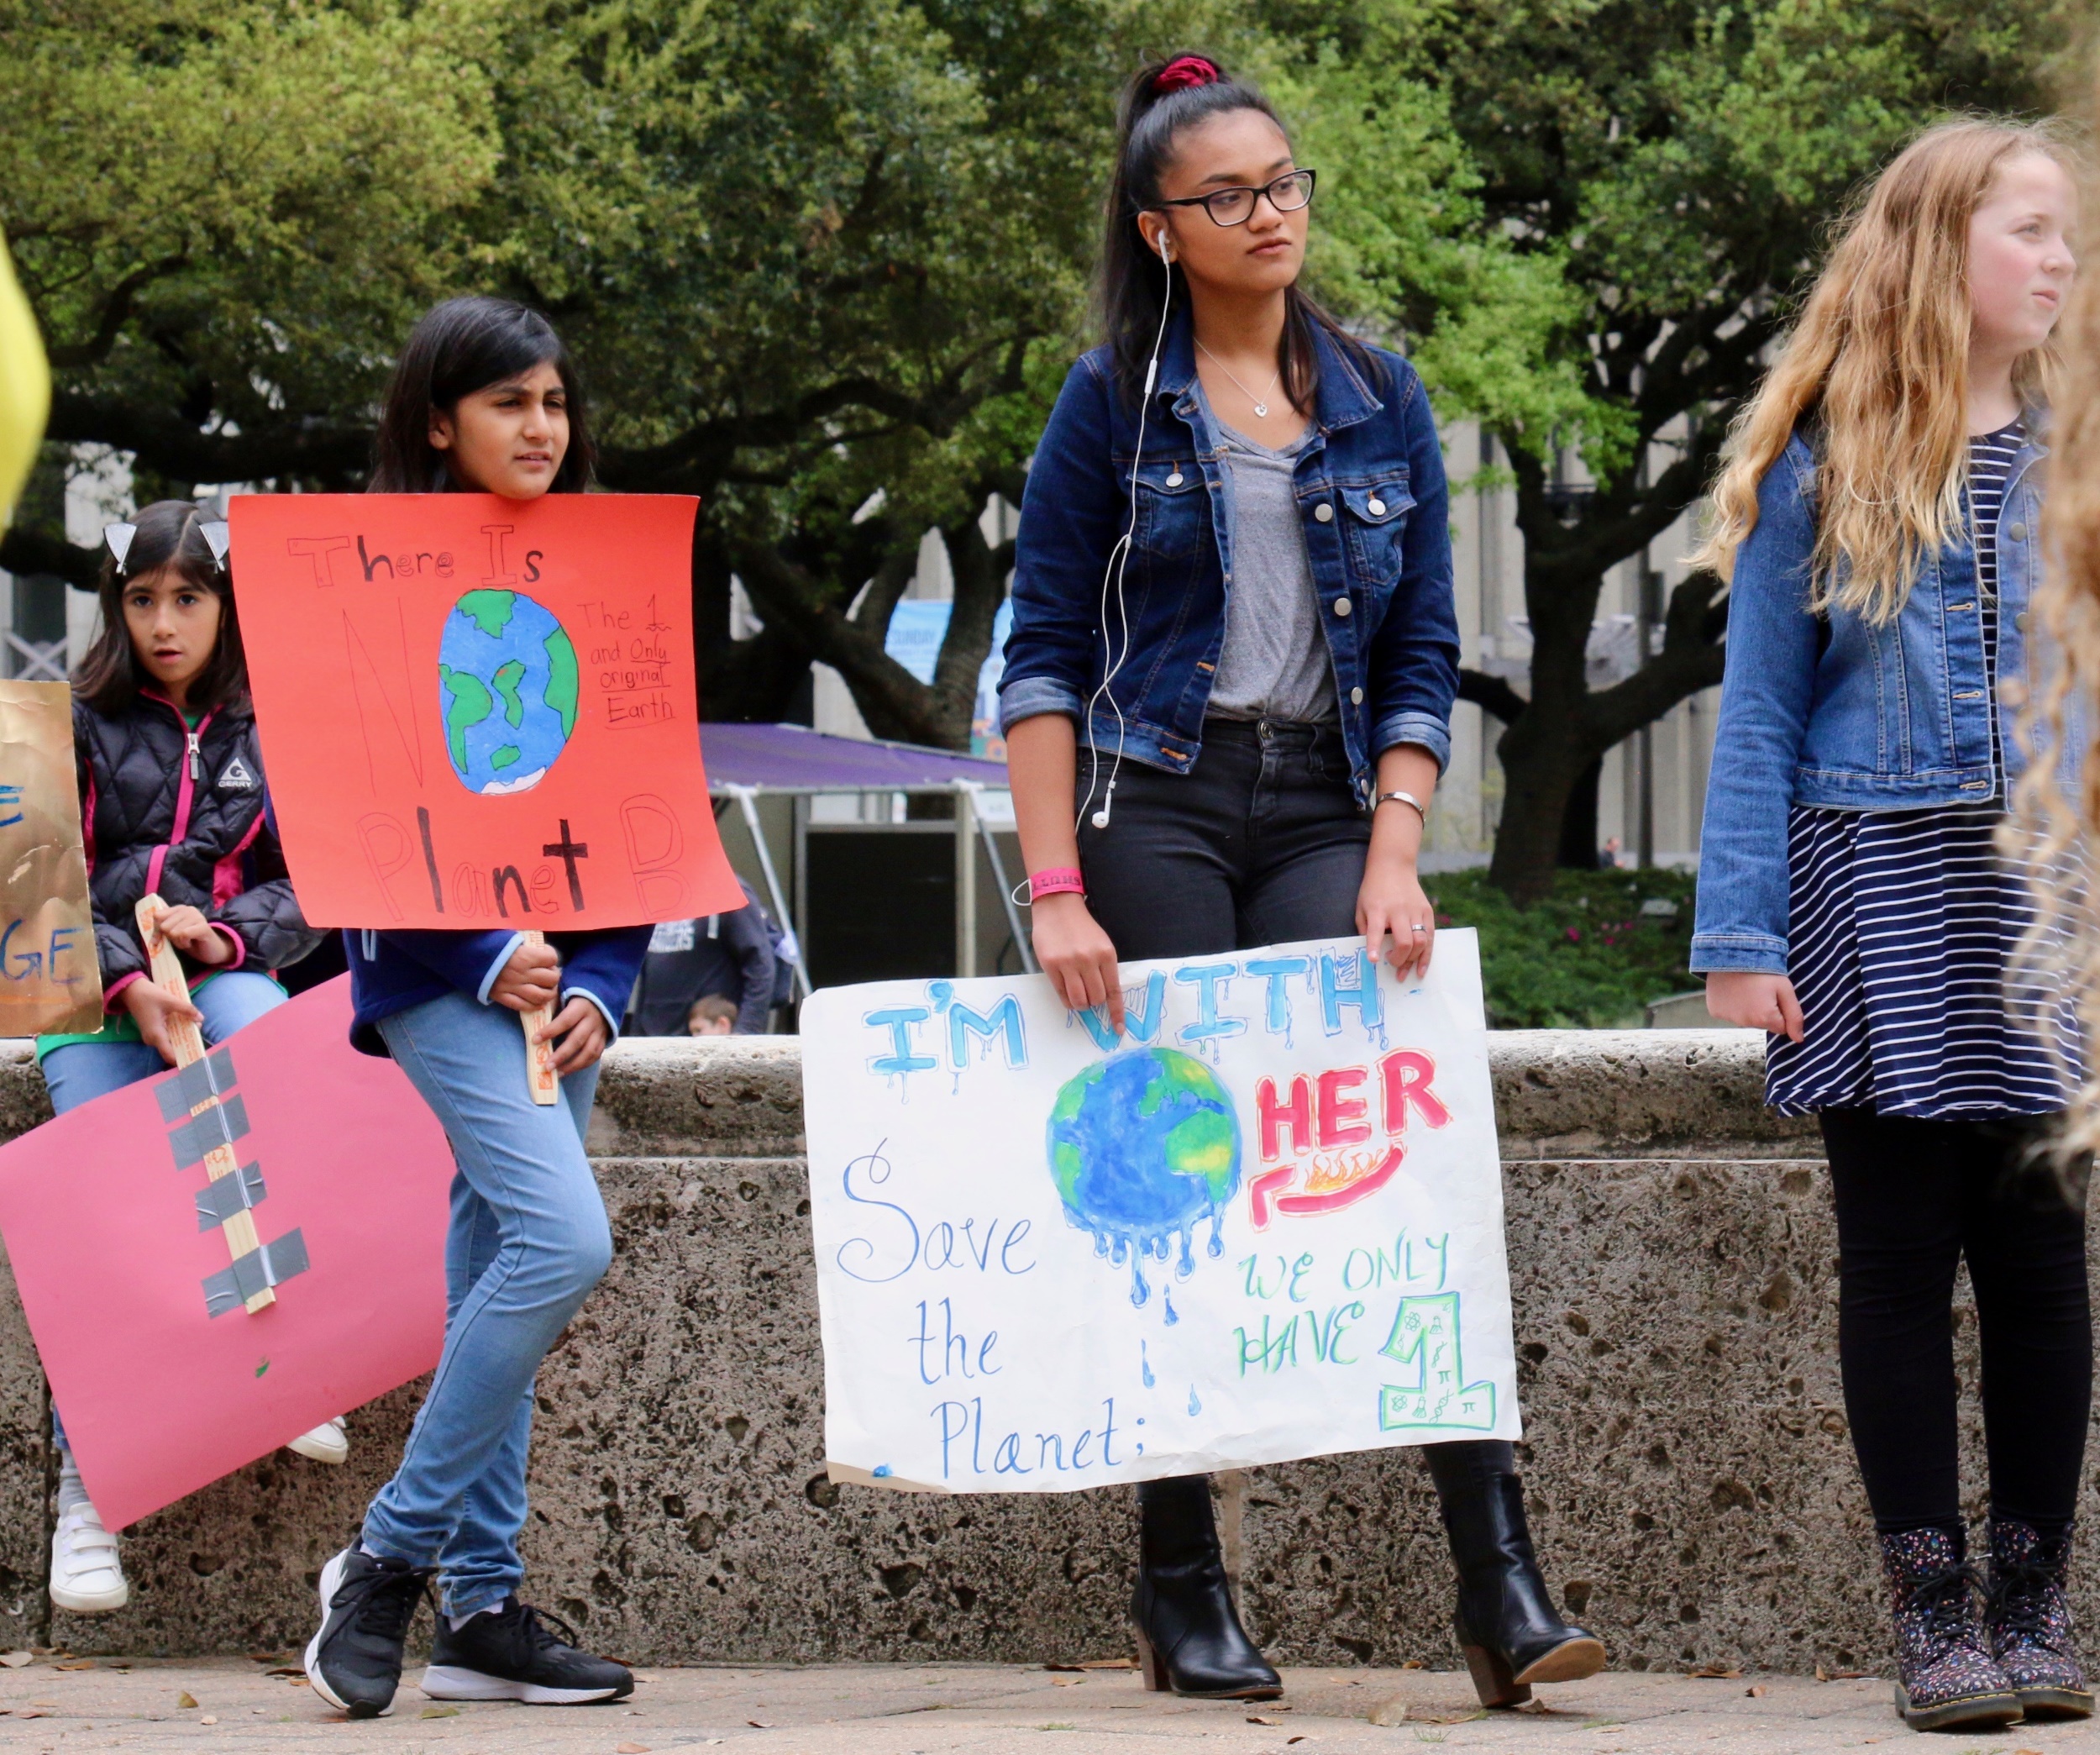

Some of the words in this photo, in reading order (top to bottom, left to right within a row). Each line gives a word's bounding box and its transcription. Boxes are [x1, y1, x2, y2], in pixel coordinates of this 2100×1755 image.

[287, 534, 454, 588] There
[480, 525, 544, 586] Is
[576, 601, 630, 630] The
[647, 593, 664, 627] 1
[591, 640, 621, 665] and
[630, 633, 667, 664] Only
[600, 662, 664, 689] original
[607, 693, 673, 722] Earth
[356, 806, 589, 922] Planet
[619, 794, 691, 920] B
[862, 980, 1029, 1076] I'M
[1256, 1047, 1453, 1164] HER
[837, 1138, 1037, 1283] Save
[1236, 1251, 1314, 1303] WE
[1343, 1226, 1449, 1291] ONLY
[907, 1296, 1003, 1385] the
[1232, 1300, 1366, 1379] HAVE
[1378, 1290, 1496, 1432] 1
